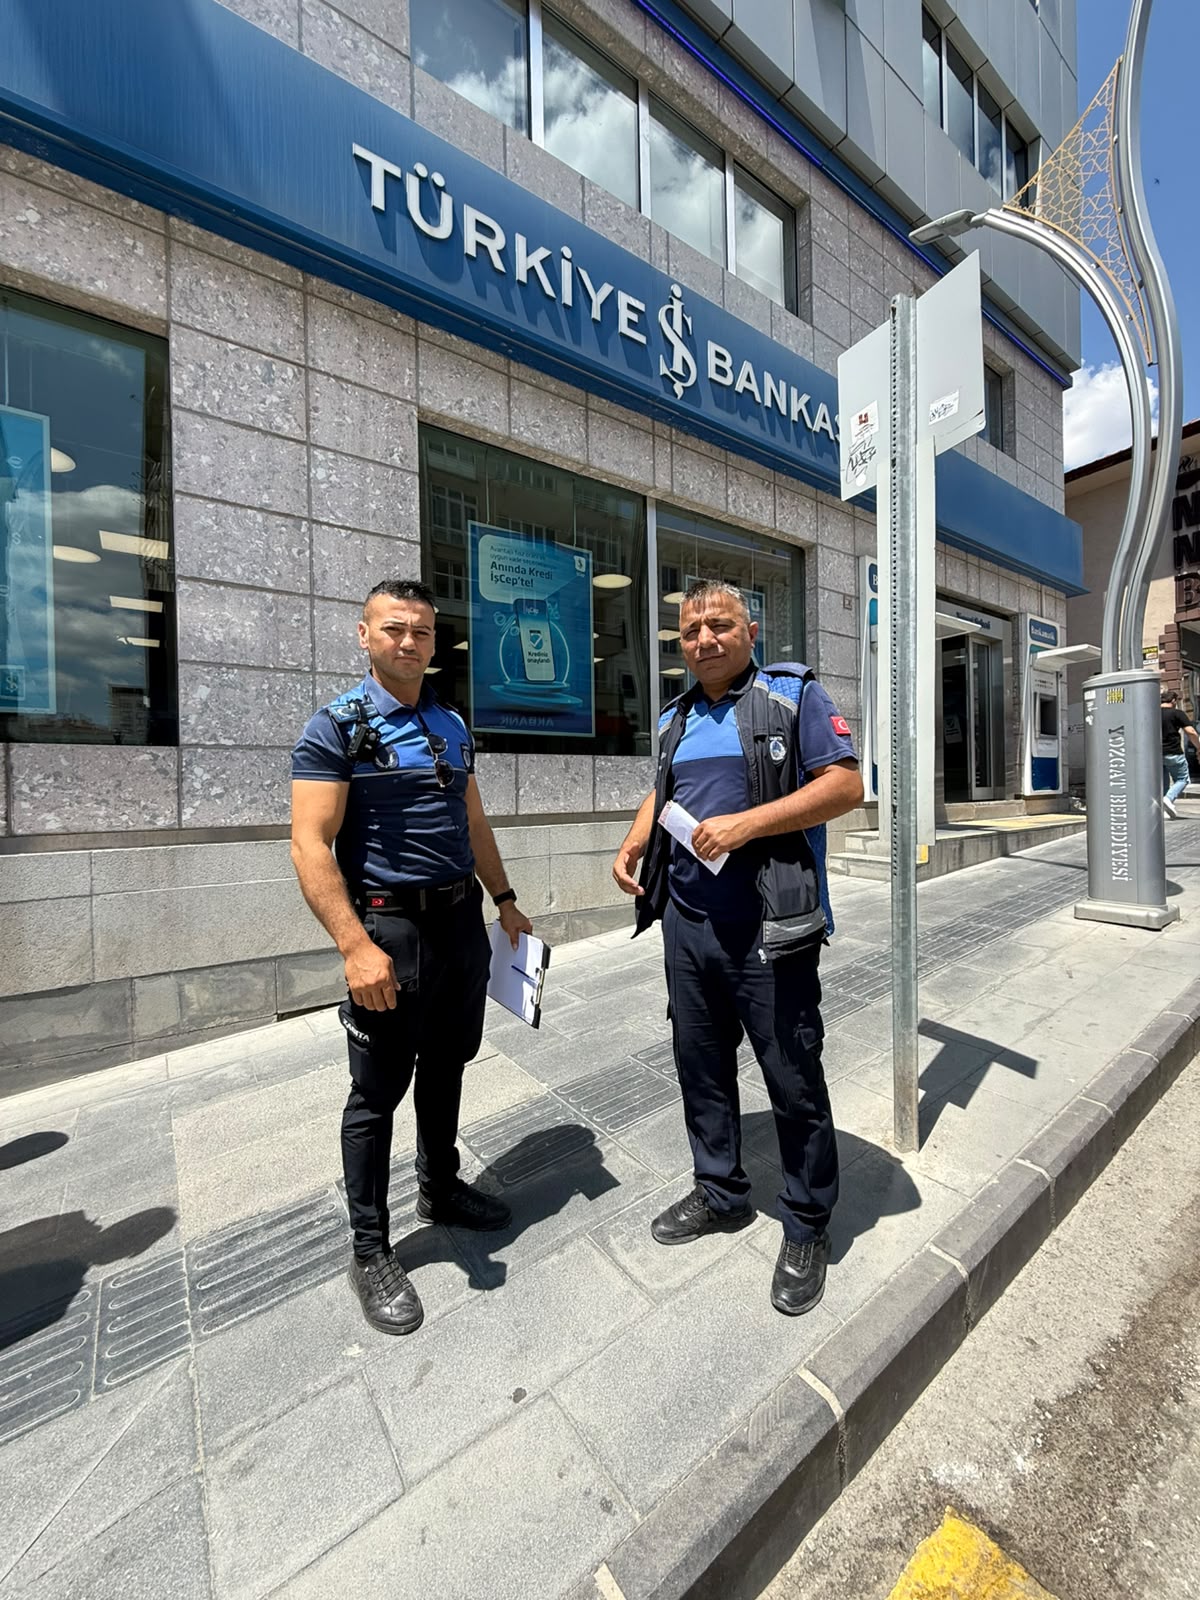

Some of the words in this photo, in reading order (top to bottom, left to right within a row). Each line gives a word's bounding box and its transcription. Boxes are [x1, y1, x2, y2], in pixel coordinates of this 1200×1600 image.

[352, 143, 647, 345] TÜRKİYE
[490, 561, 527, 575] Anında
[529, 567, 553, 581] Kredi
[1108, 725, 1127, 789] YOZGAT
[1110, 793, 1133, 882] BELEDİYESİ
